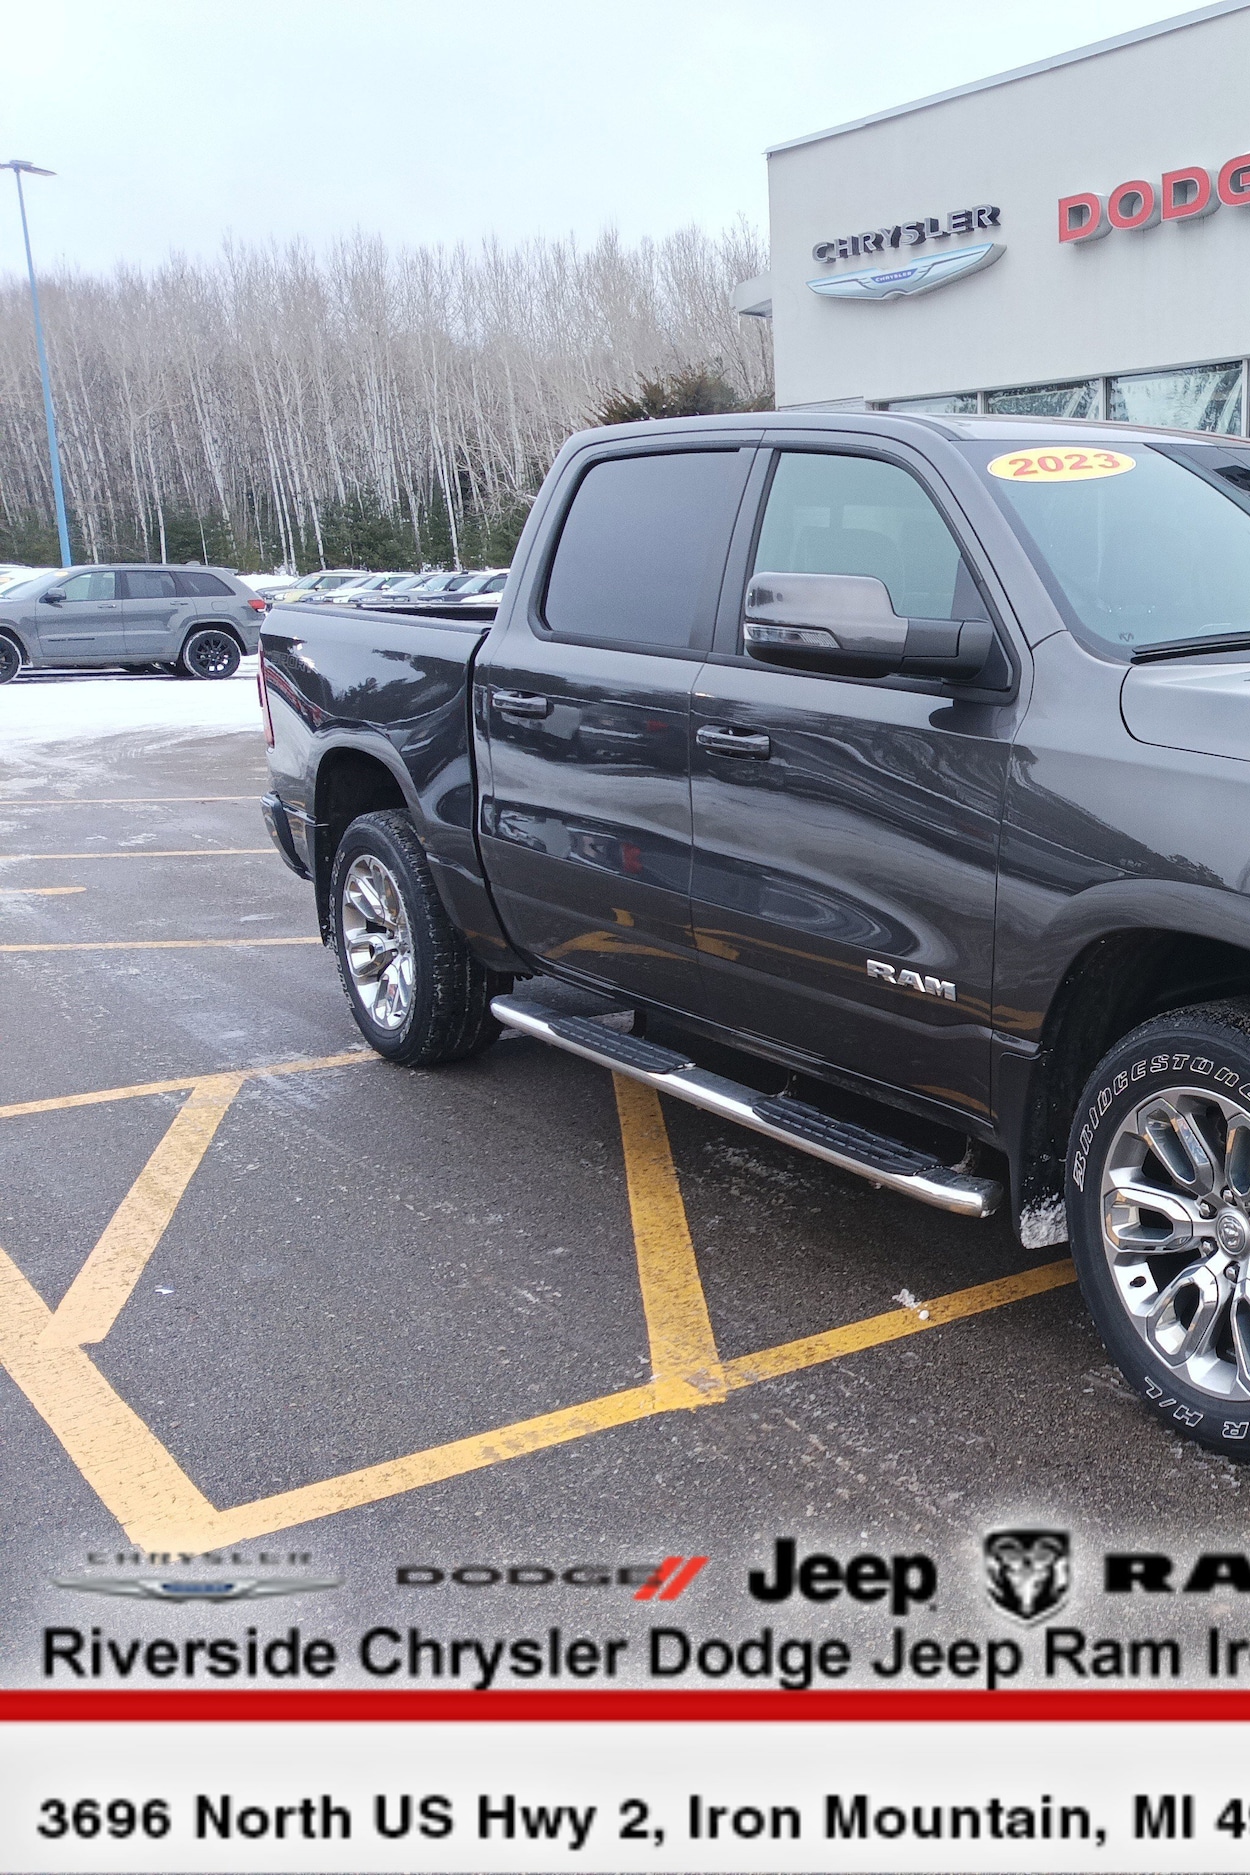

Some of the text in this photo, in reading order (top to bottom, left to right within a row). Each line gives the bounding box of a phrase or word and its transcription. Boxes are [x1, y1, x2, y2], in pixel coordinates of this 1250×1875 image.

[812, 203, 1001, 264] CHRYSLER
[874, 270, 913, 283] CHRYSLER
[1008, 453, 1120, 477] 2023
[866, 958, 957, 1002] RAM
[1143, 1375, 1204, 1428] H/L
